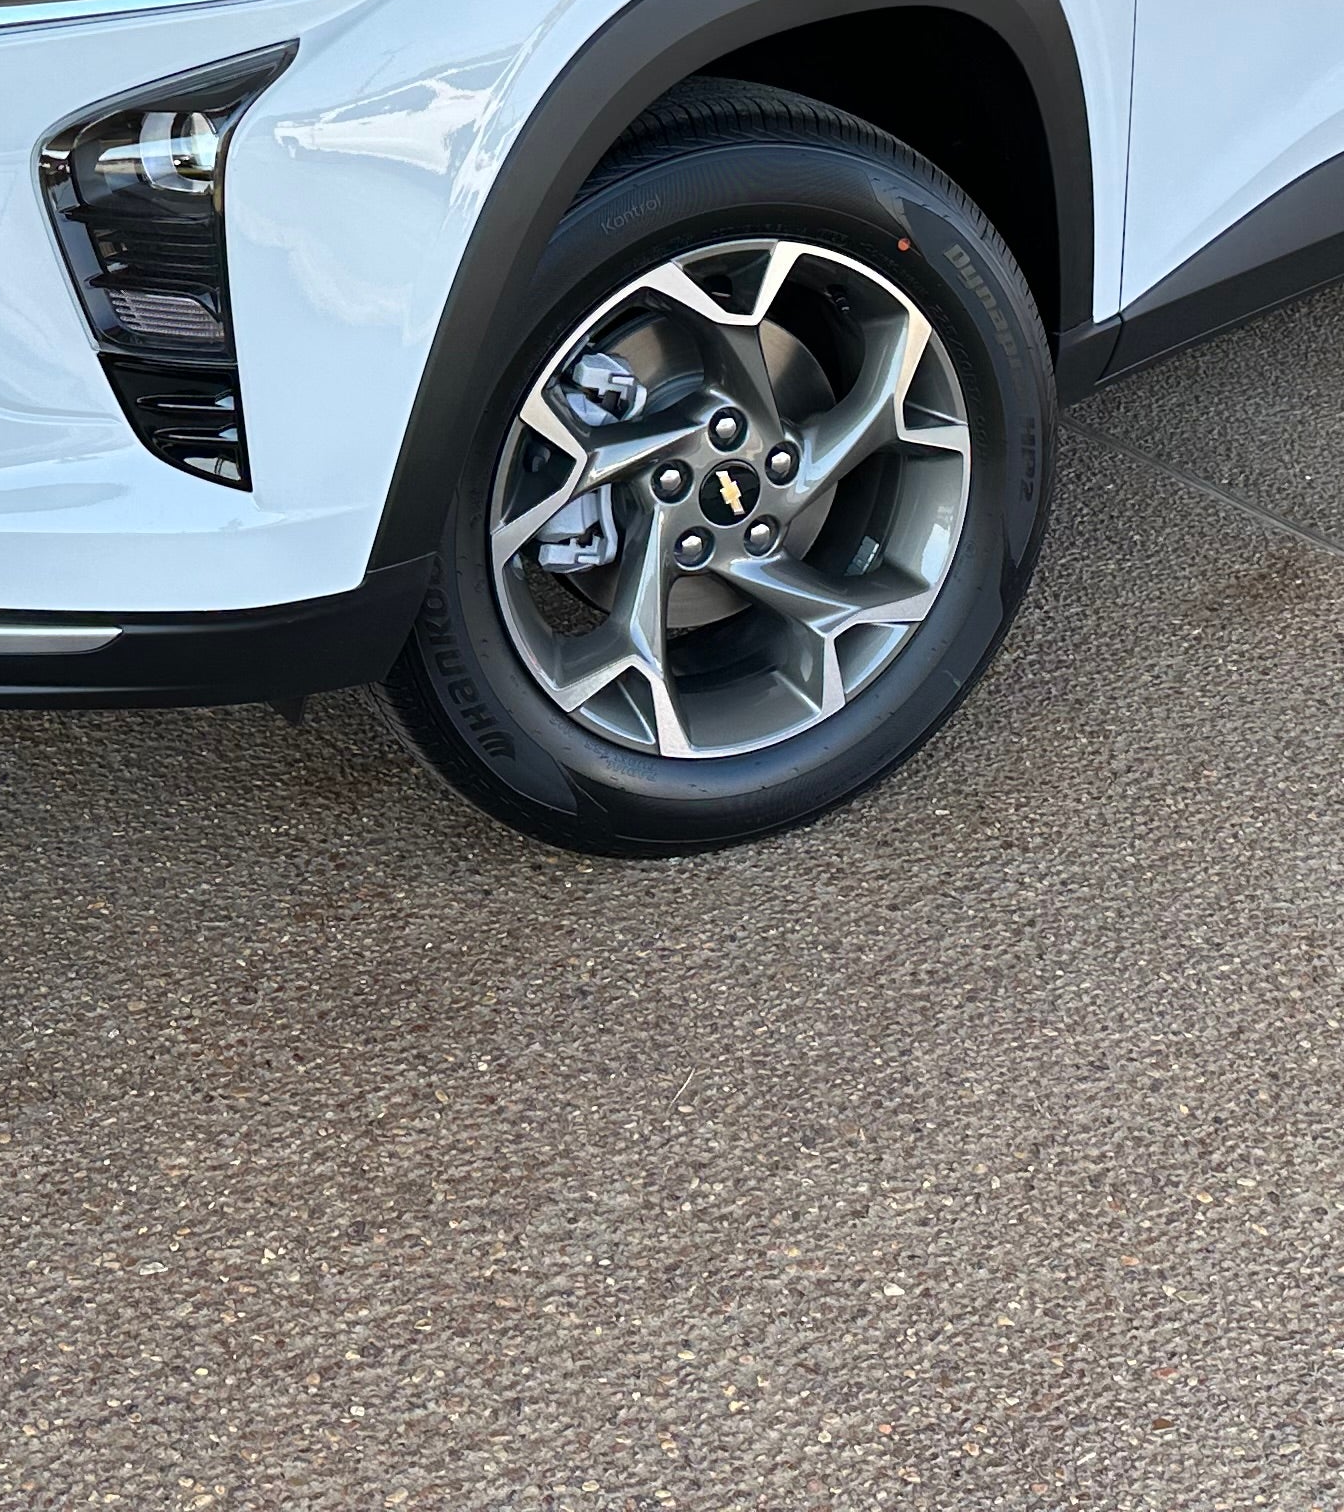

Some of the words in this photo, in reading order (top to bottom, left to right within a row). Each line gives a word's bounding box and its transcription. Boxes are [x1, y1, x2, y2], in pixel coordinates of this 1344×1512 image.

[600, 194, 662, 234] Kontrol
[943, 243, 1026, 391] Dynap
[1020, 416, 1036, 503] HP2
[423, 554, 499, 731] Hanko
